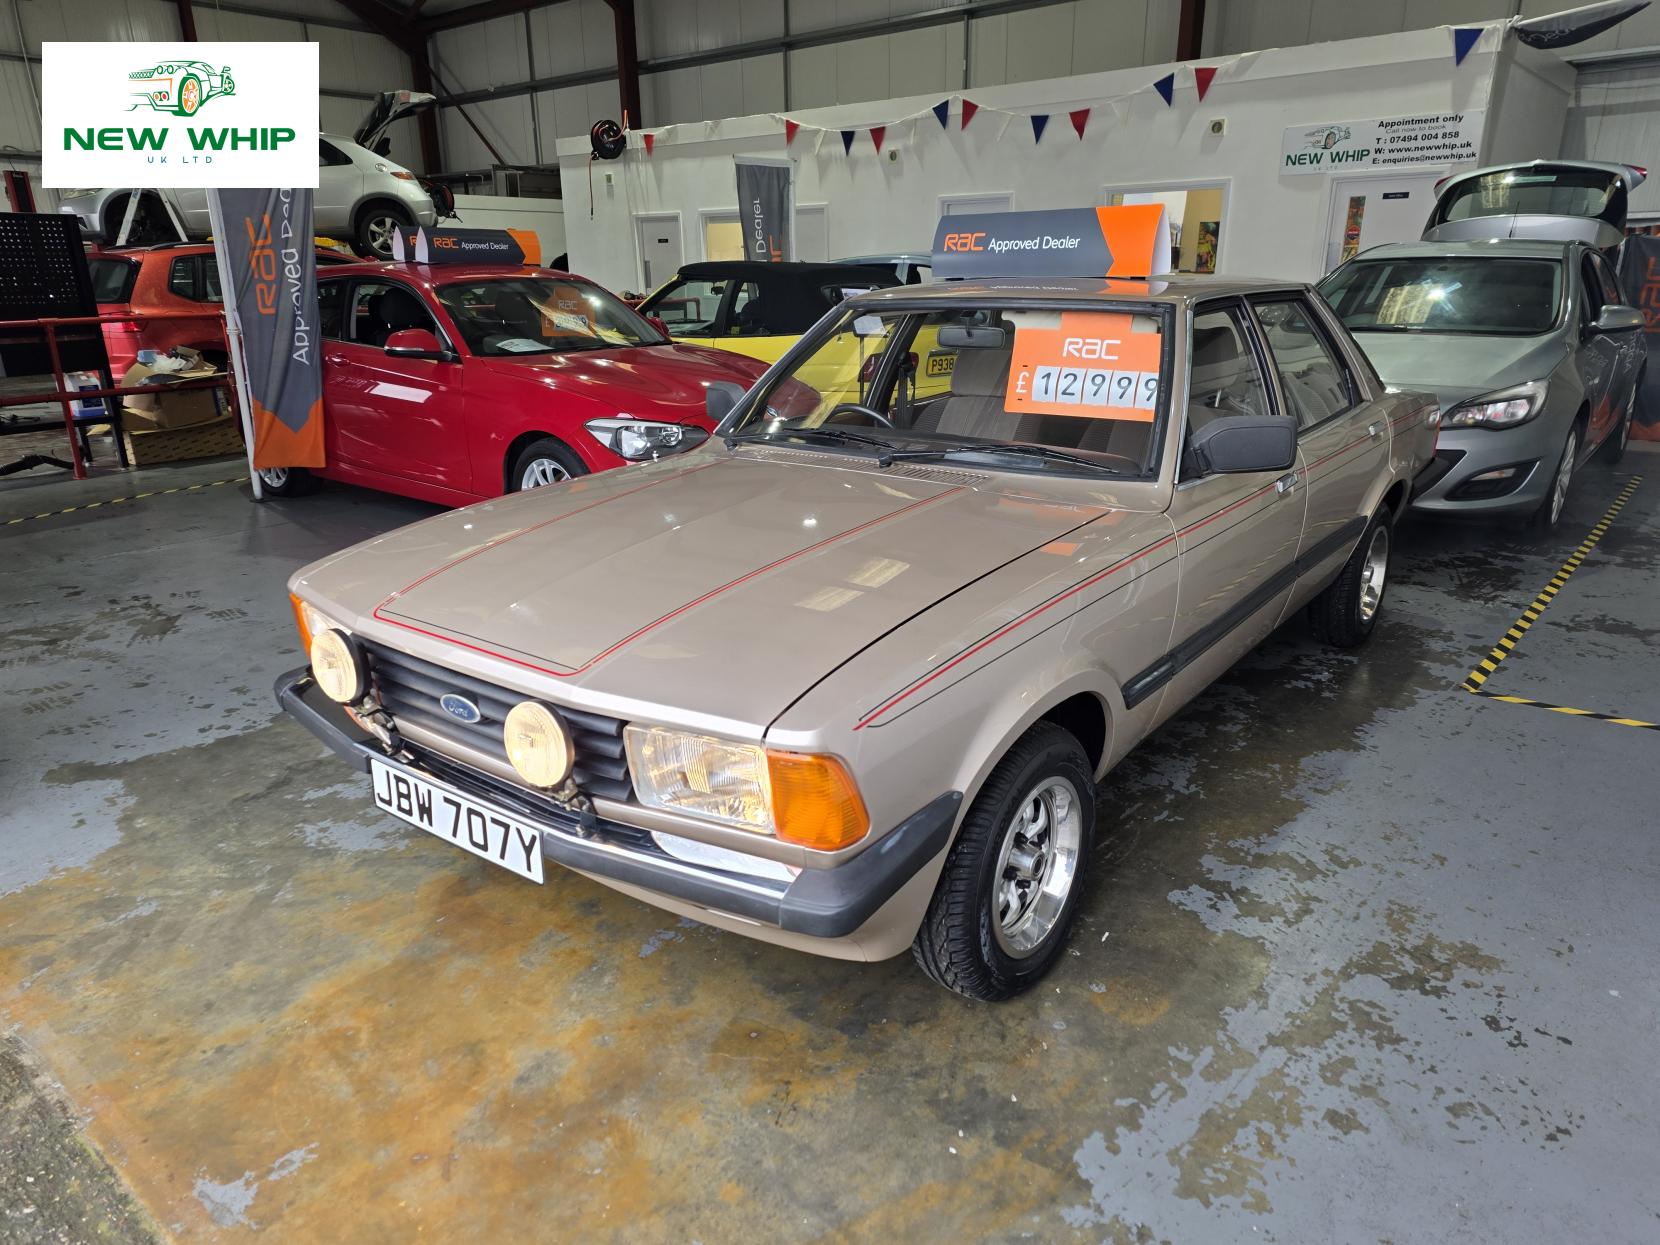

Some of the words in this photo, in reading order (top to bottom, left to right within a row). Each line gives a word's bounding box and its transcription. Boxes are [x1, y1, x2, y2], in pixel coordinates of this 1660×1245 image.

[1378, 116, 1440, 129] Appointment
[1442, 113, 1464, 123] only
[1389, 134, 1418, 144] 07494
[1421, 132, 1439, 141] 004
[1441, 130, 1460, 140] 858
[1374, 147, 1386, 155] W:
[1388, 140, 1472, 154] www.newwhip.uk
[1286, 152, 1324, 166] NEW
[1330, 149, 1370, 163] WHIP
[1372, 157, 1380, 165] E:
[461, 241, 490, 251] Approved
[490, 242, 509, 250] Dealer
[988, 236, 1040, 254] Approved
[1042, 236, 1081, 249] Dealer
[931, 358, 954, 372] P938
[447, 701, 469, 718] Ford
[377, 770, 433, 827] JBW
[443, 796, 537, 873] 707Y
